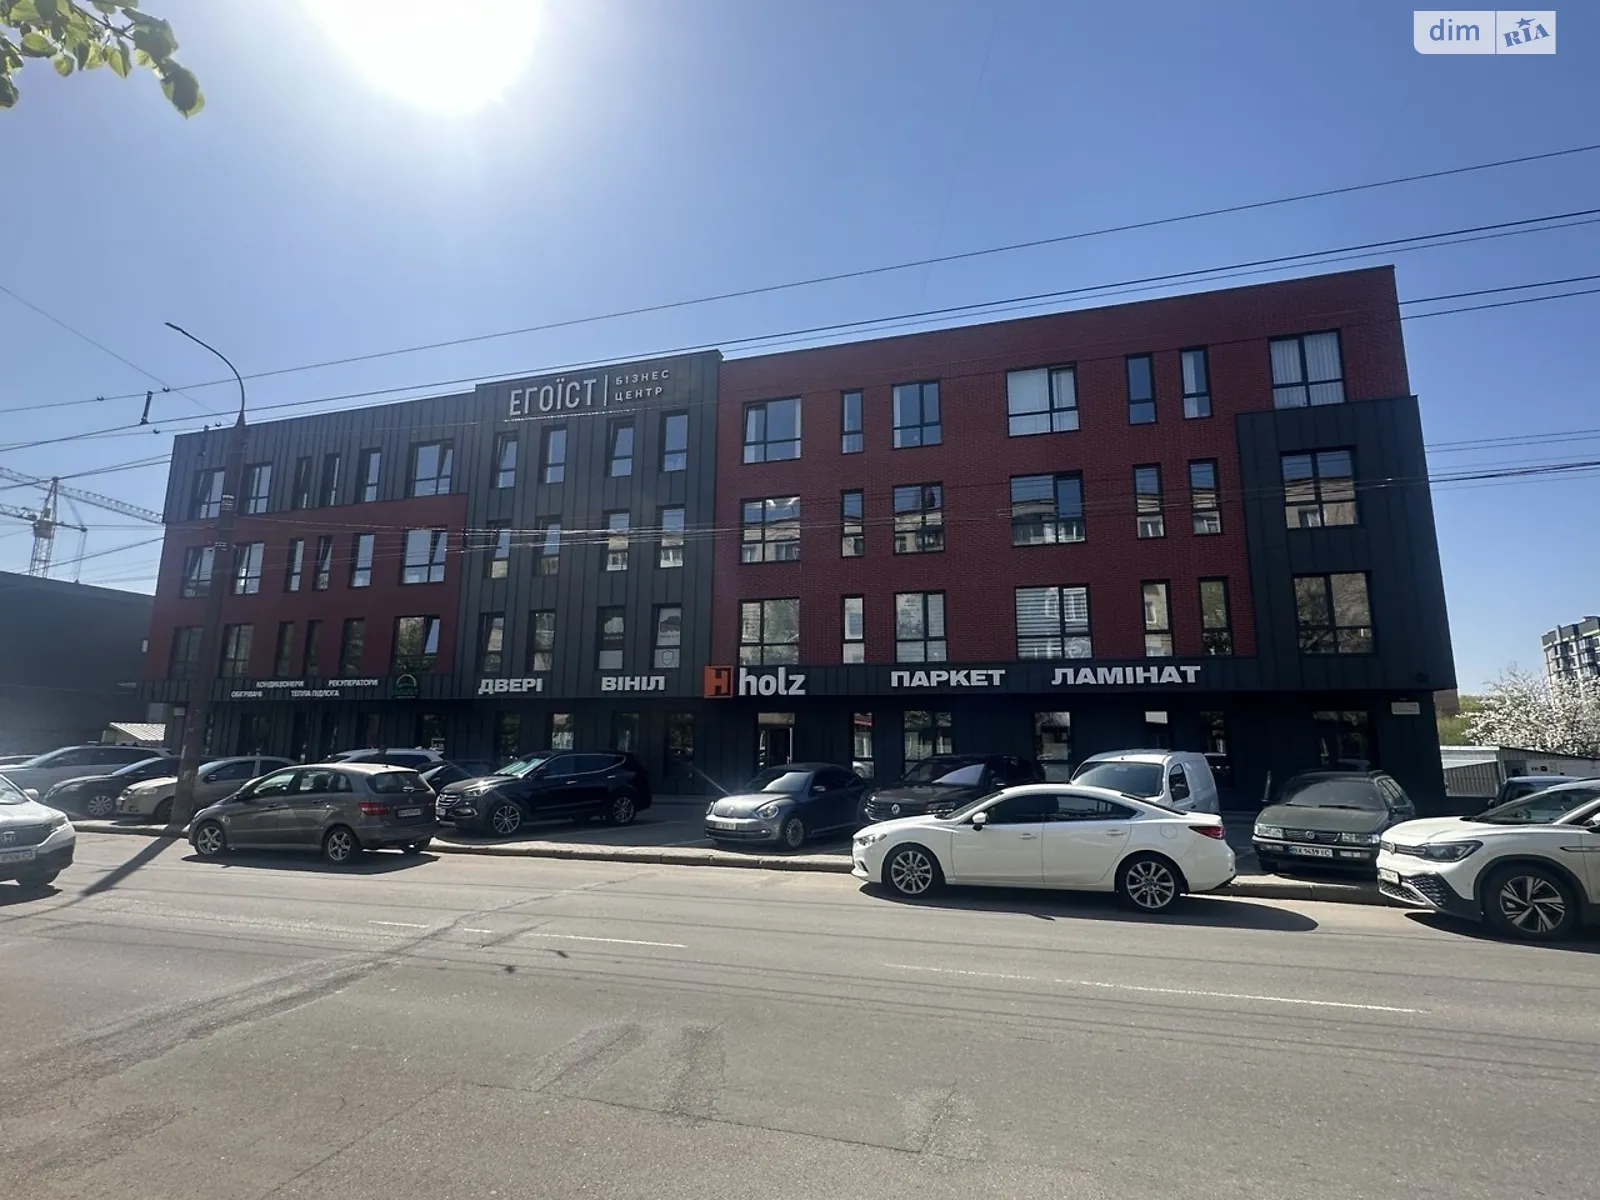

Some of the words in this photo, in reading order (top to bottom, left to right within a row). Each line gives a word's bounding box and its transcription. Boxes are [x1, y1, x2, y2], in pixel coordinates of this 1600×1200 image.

[615, 369, 669, 385] БІЗНЕС
[509, 378, 597, 416] ЕГОЇСТ
[615, 386, 663, 402] ЦЕНТР
[601, 675, 666, 691] ВІНІЛ
[738, 666, 806, 696] holz
[890, 669, 1006, 687] ПАРКЕТ
[1051, 665, 1201, 686] ЛАМІНАТ
[478, 678, 543, 695] ДВЕРІ
